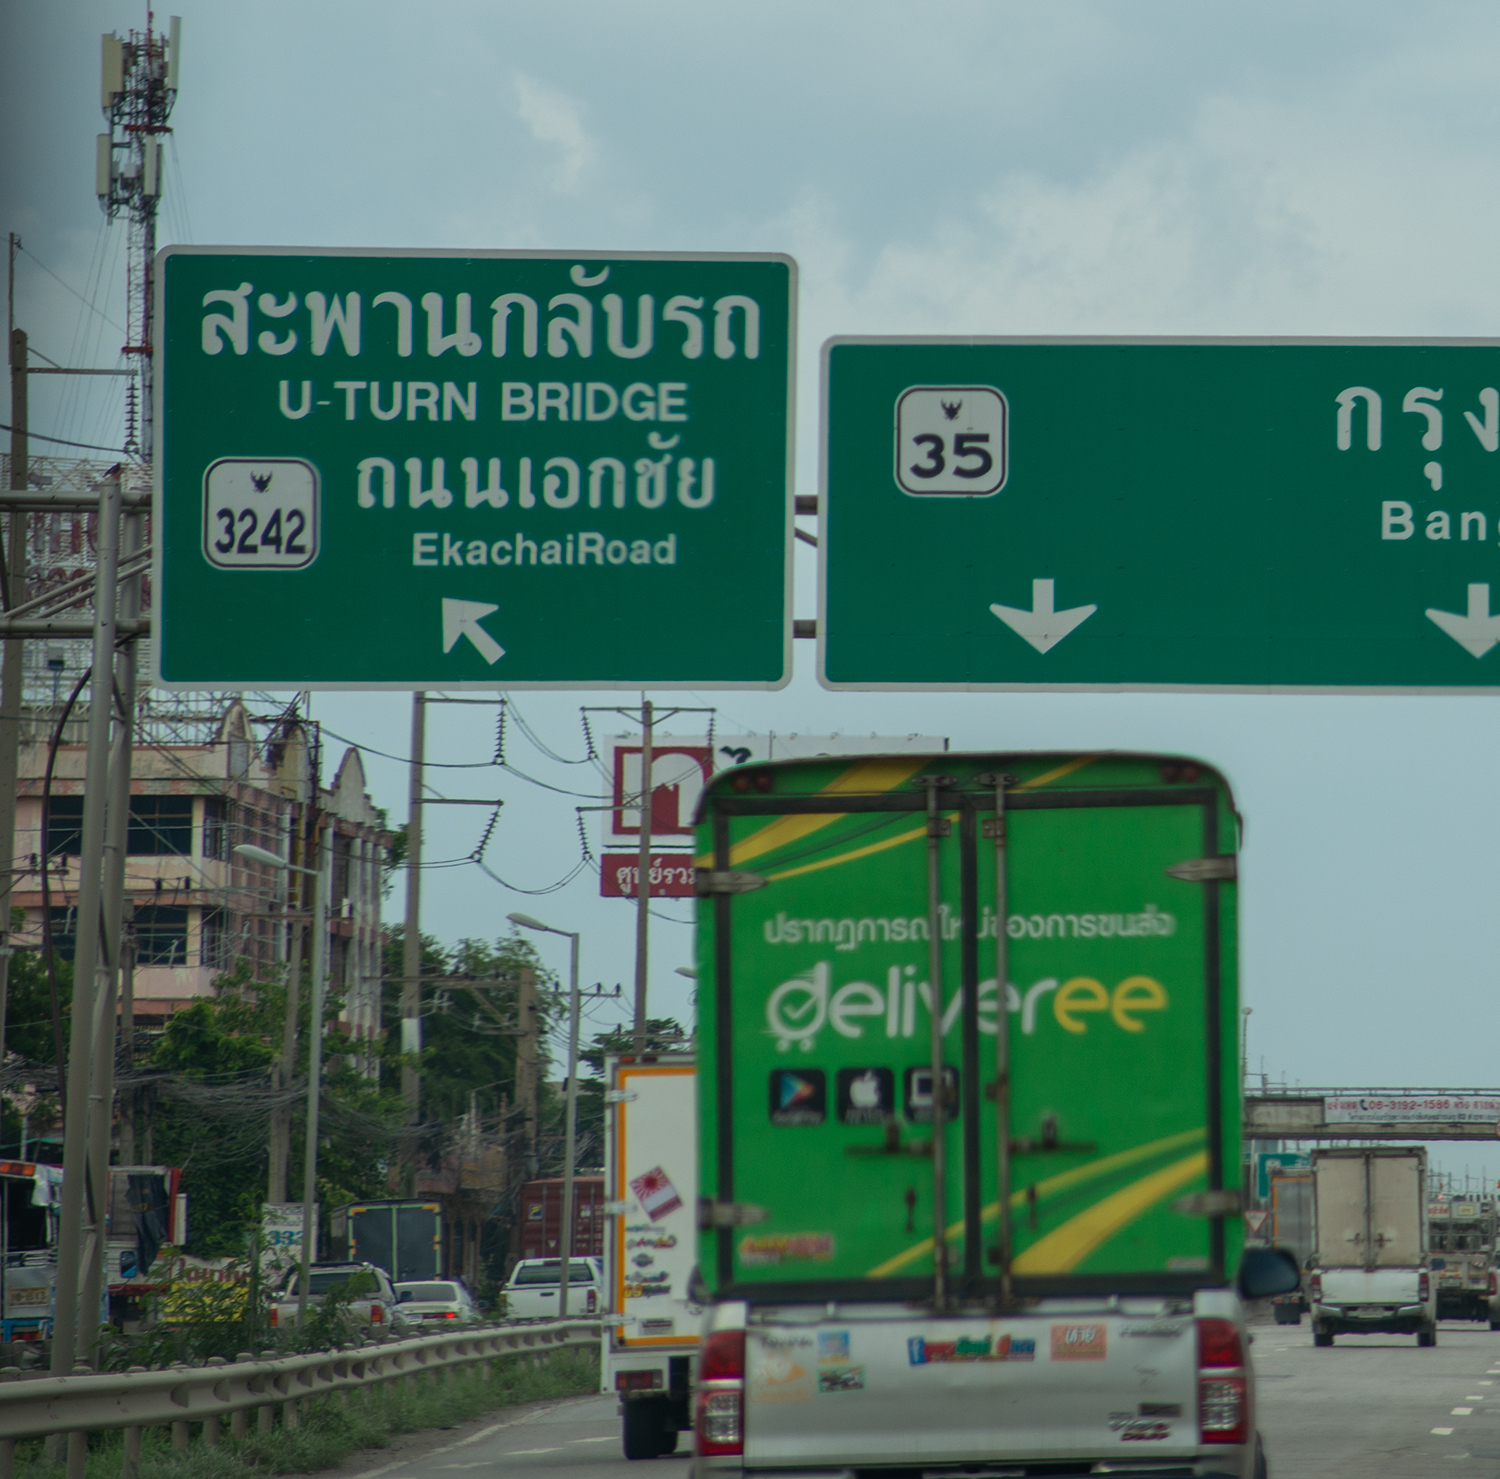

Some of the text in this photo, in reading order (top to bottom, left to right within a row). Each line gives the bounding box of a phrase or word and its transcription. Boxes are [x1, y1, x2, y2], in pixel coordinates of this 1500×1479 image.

[202, 264, 761, 359] สะพานกลับรถ
[279, 381, 688, 421] U-TURN BRIDGE
[357, 432, 715, 509] ถนนเอกชัย
[909, 433, 993, 479] 35
[215, 508, 307, 556] 3242
[766, 961, 1168, 1040] deliveree
